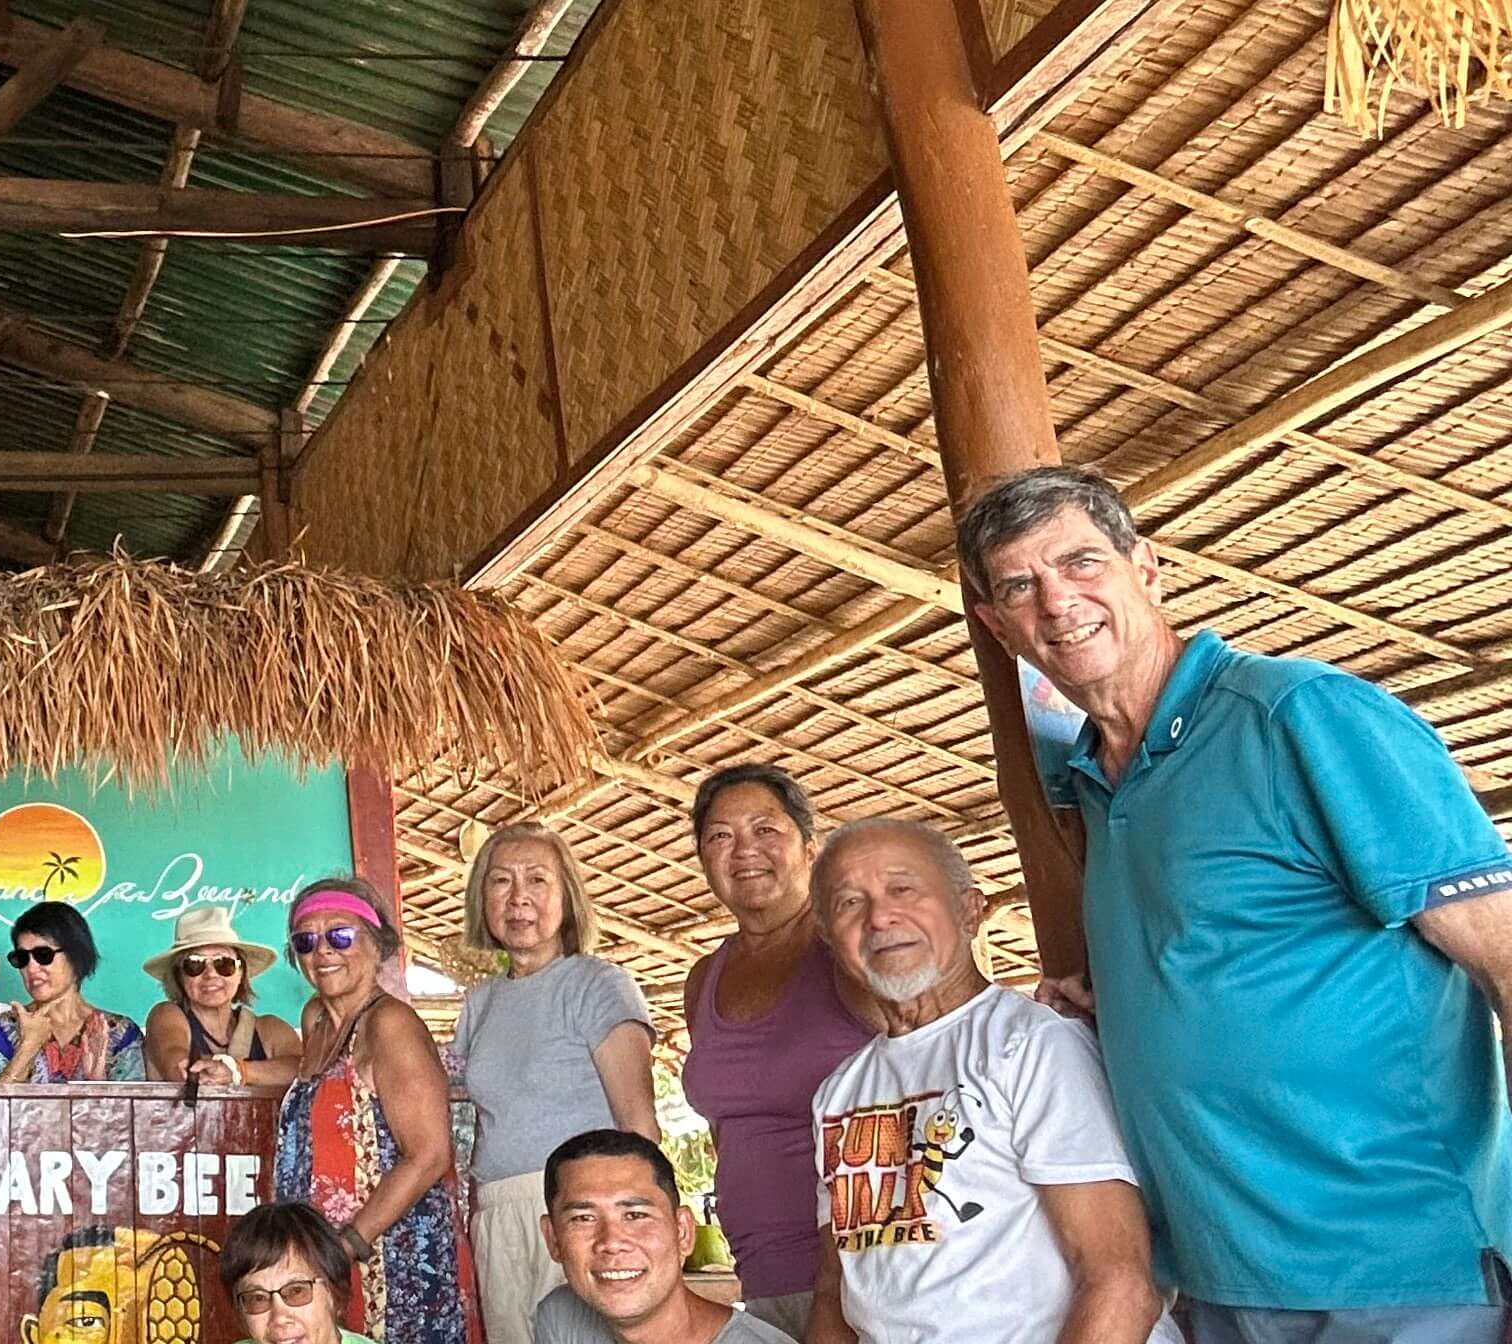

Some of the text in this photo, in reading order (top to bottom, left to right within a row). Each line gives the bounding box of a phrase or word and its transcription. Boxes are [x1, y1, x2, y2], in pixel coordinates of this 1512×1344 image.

[823, 1113, 908, 1178] RUN
[138, 1151, 261, 1216] BEE
[893, 1223, 936, 1242] BEE
